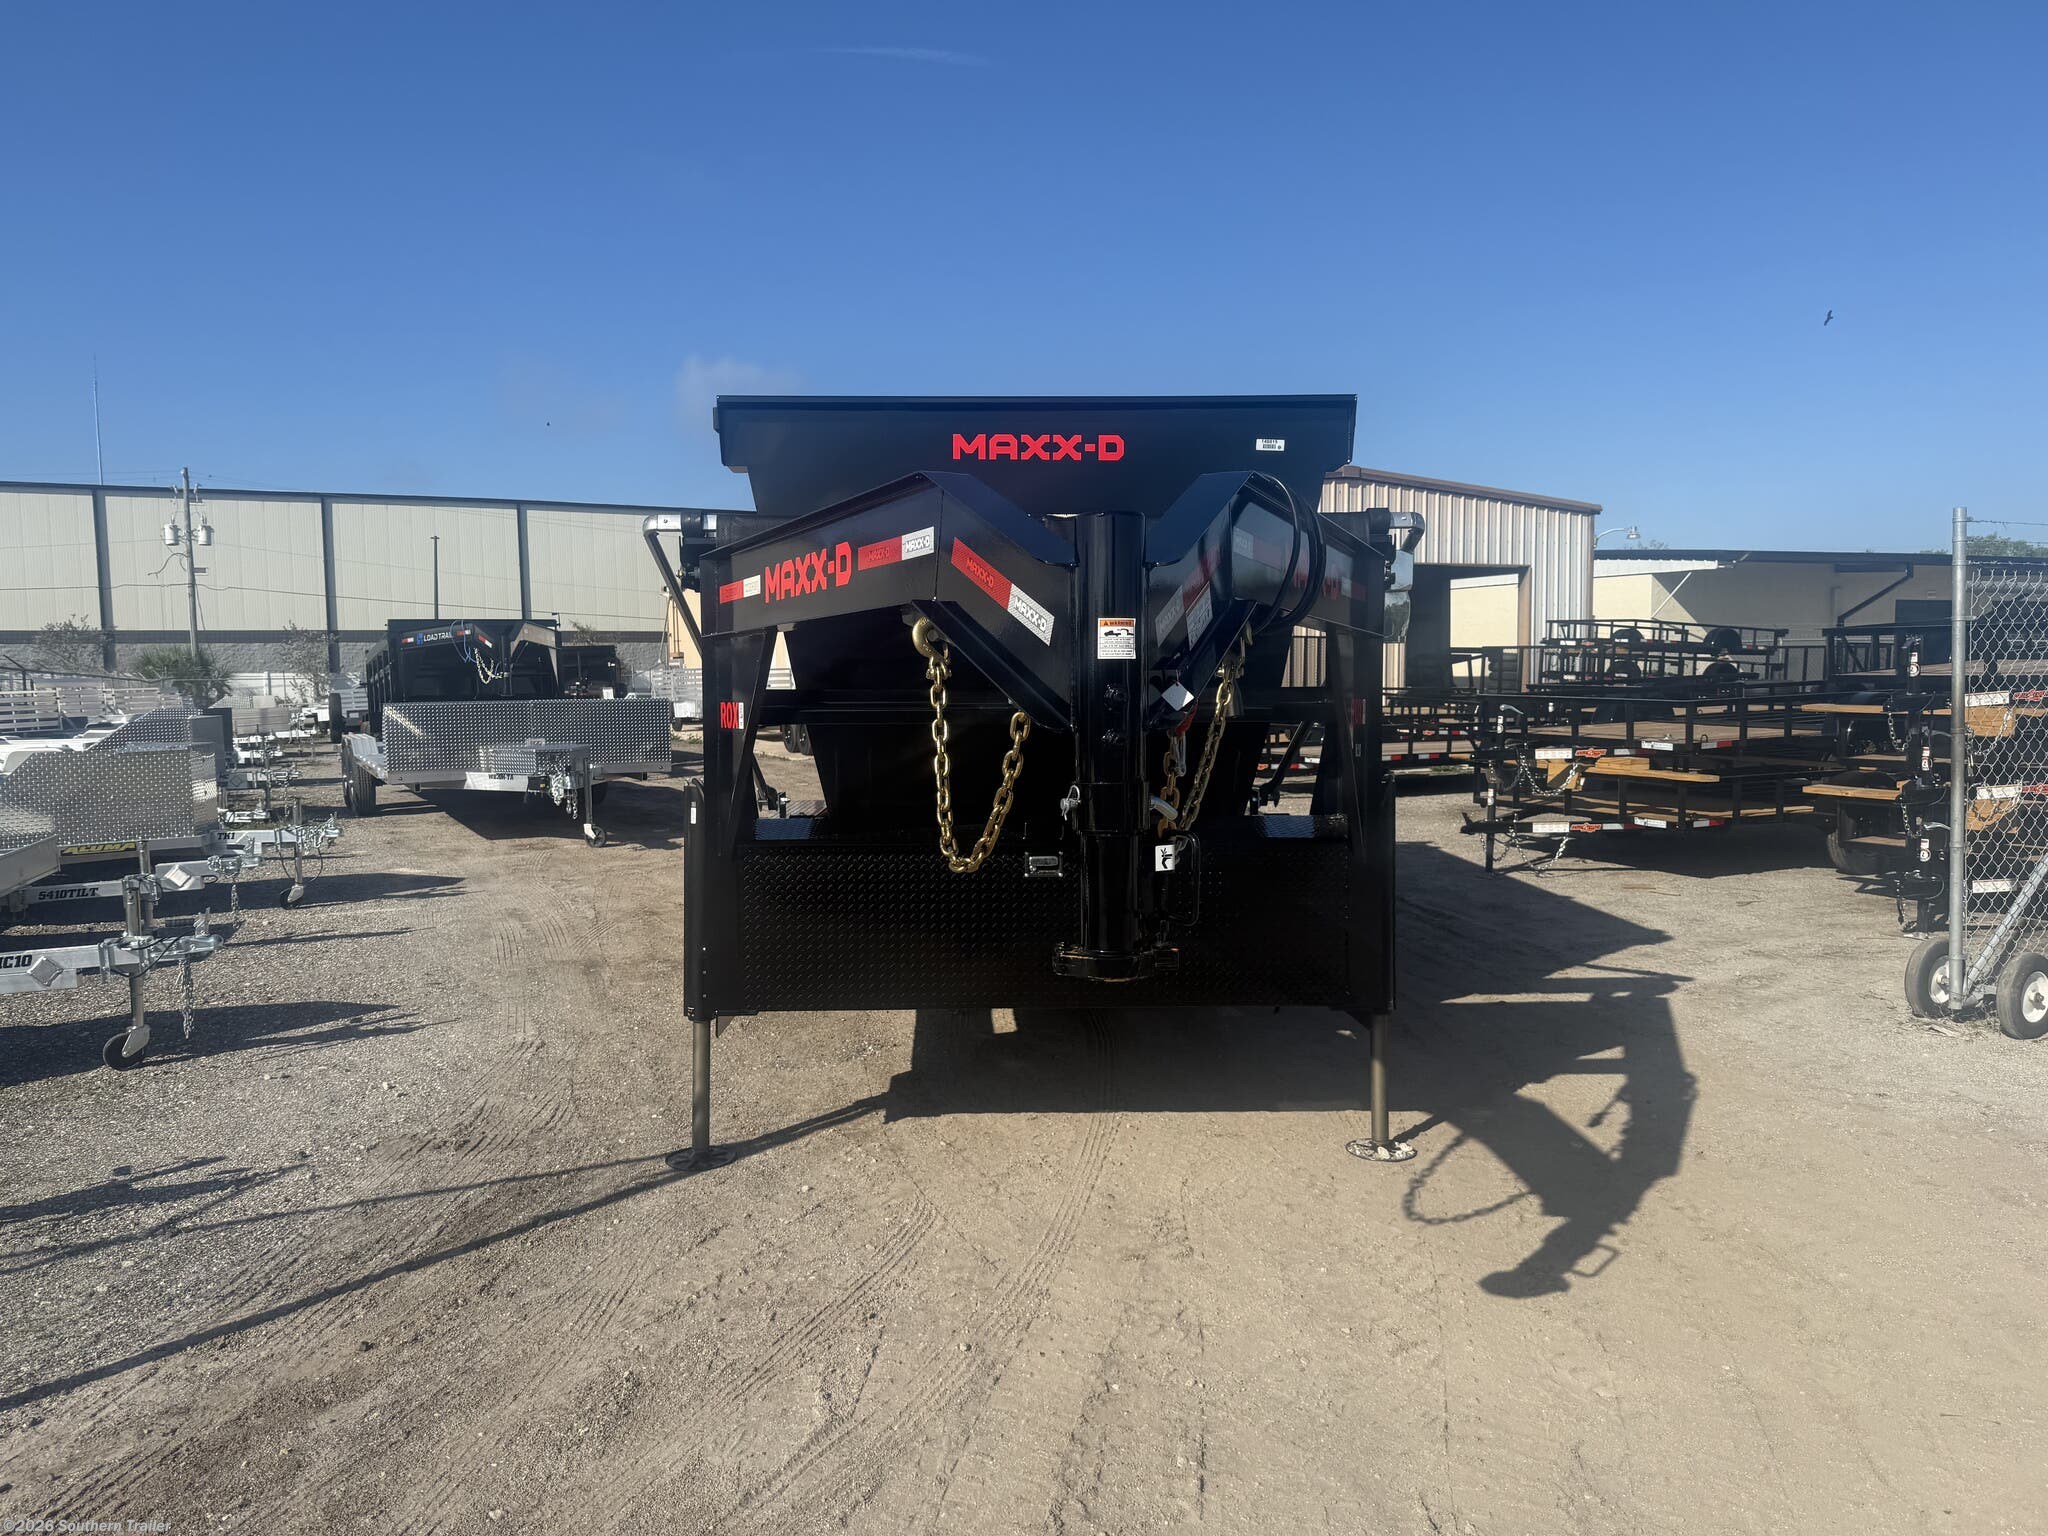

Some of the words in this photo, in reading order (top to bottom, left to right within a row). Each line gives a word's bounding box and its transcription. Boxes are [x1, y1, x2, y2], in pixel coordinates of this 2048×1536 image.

[952, 433, 1125, 461] MAXX-D
[764, 541, 852, 604] MAXX-D
[1012, 594, 1048, 633] MAXX-D
[720, 701, 739, 729] ROX
[61, 841, 136, 855] ALUMA
[0, 954, 33, 969] C10
